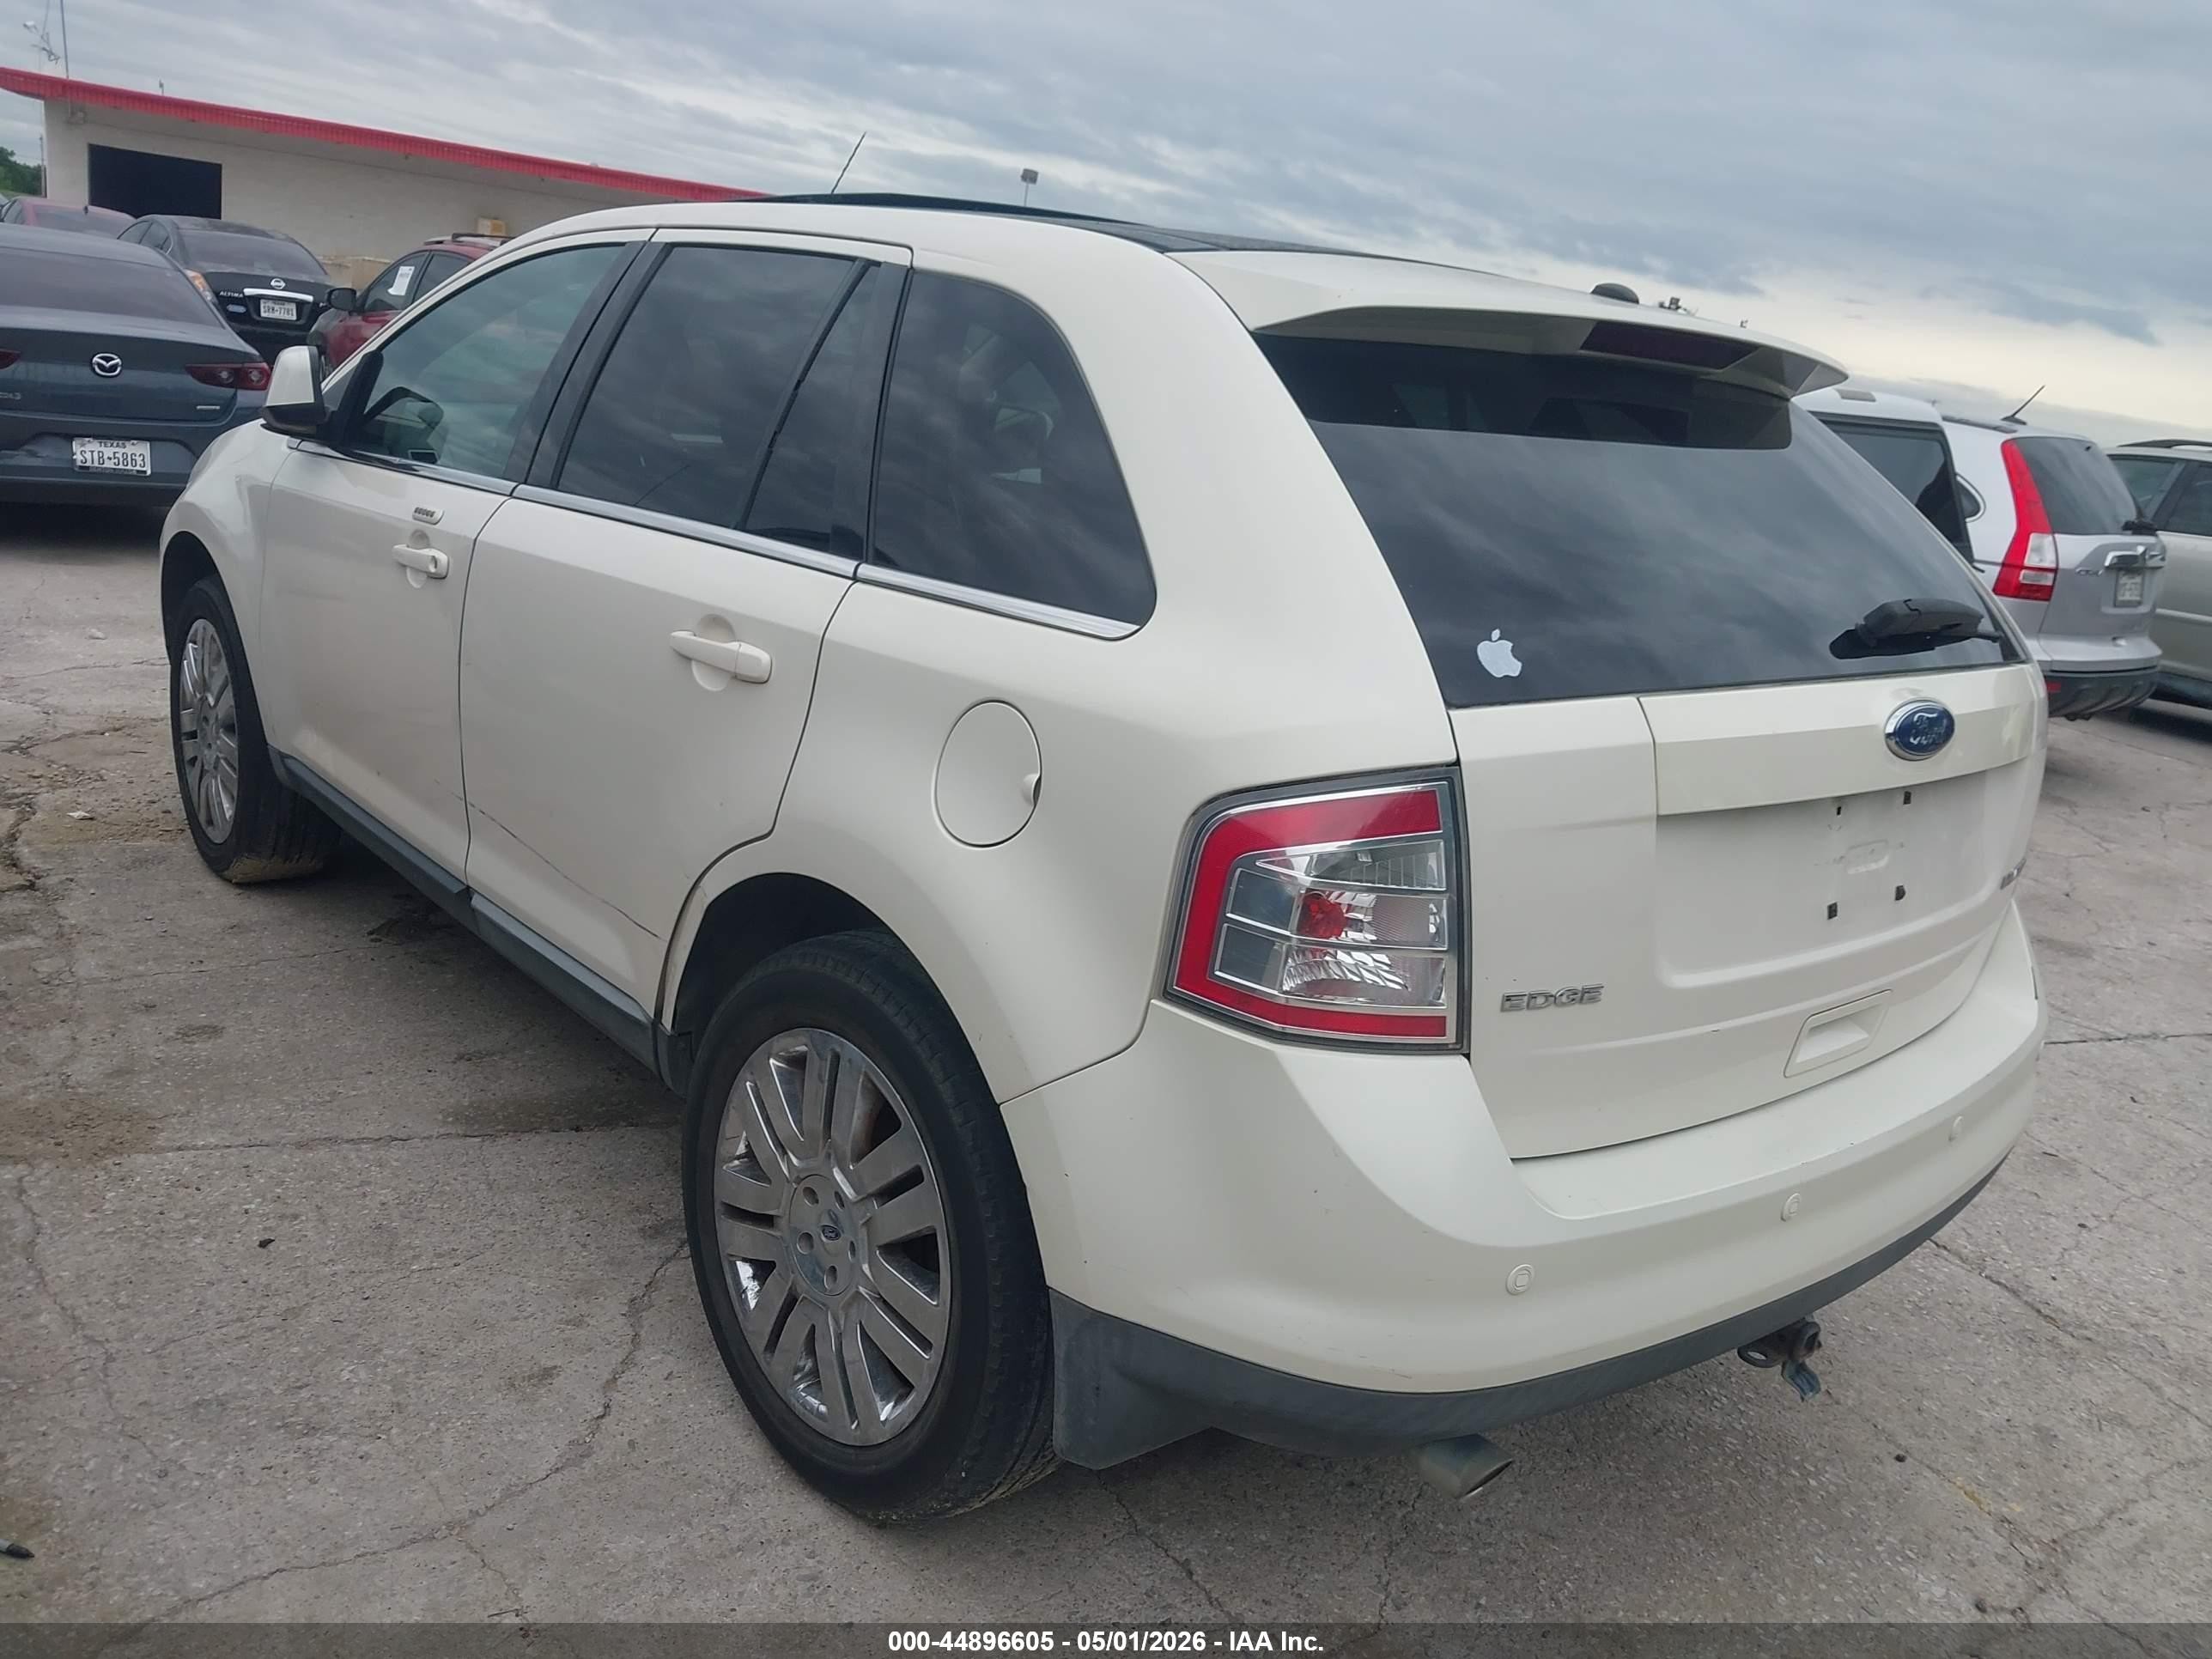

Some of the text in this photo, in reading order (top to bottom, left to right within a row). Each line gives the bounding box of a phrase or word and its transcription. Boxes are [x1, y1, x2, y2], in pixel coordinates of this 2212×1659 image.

[98, 441, 127, 449] TEXAS
[1908, 711, 1948, 746] Ford
[1500, 983, 1604, 1012] EDGE
